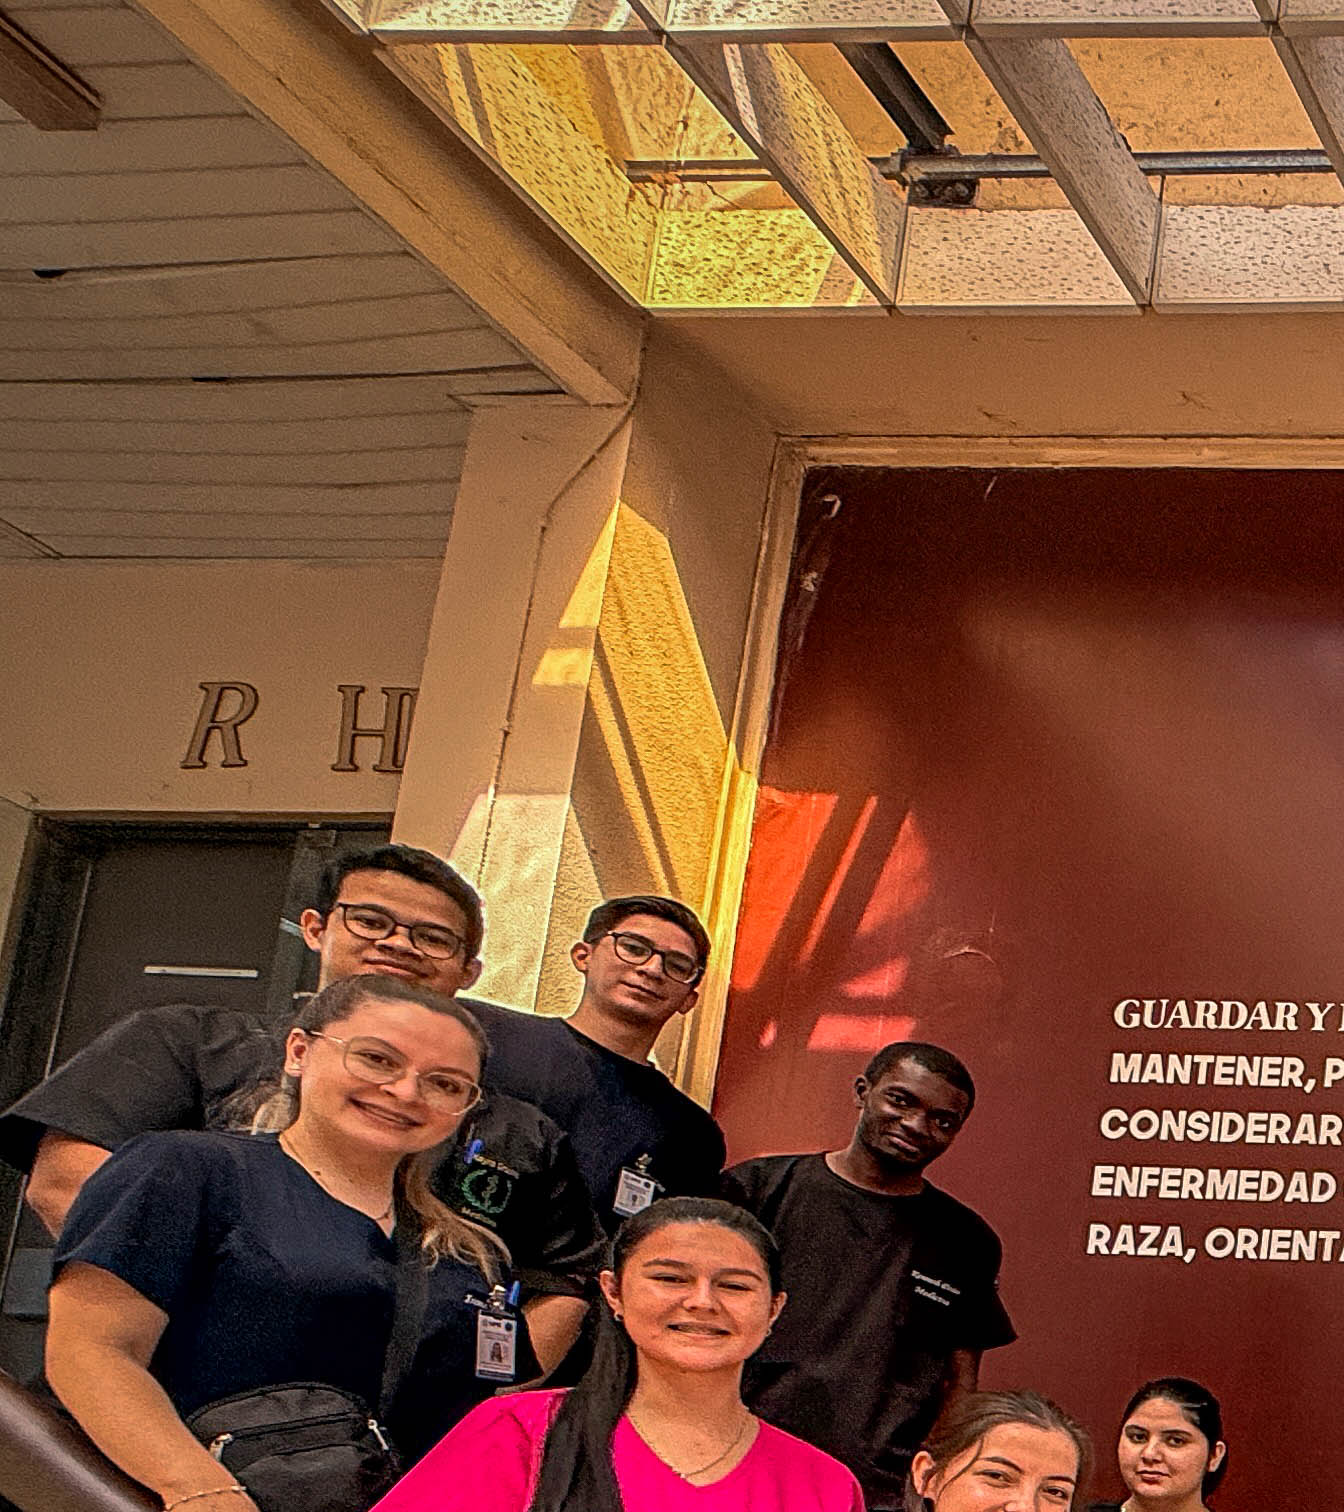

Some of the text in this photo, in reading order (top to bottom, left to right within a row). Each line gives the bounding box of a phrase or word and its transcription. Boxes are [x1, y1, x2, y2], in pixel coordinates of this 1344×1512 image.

[1113, 999, 1299, 1031] GUARDAR
[1305, 1002, 1336, 1032] Y
[1109, 1052, 1316, 1094] MANTENER,
[1100, 1108, 1343, 1146] CONSIDERAR
[1091, 1165, 1337, 1203] ENFERMEDAD
[1086, 1223, 1196, 1264] RAZA,
